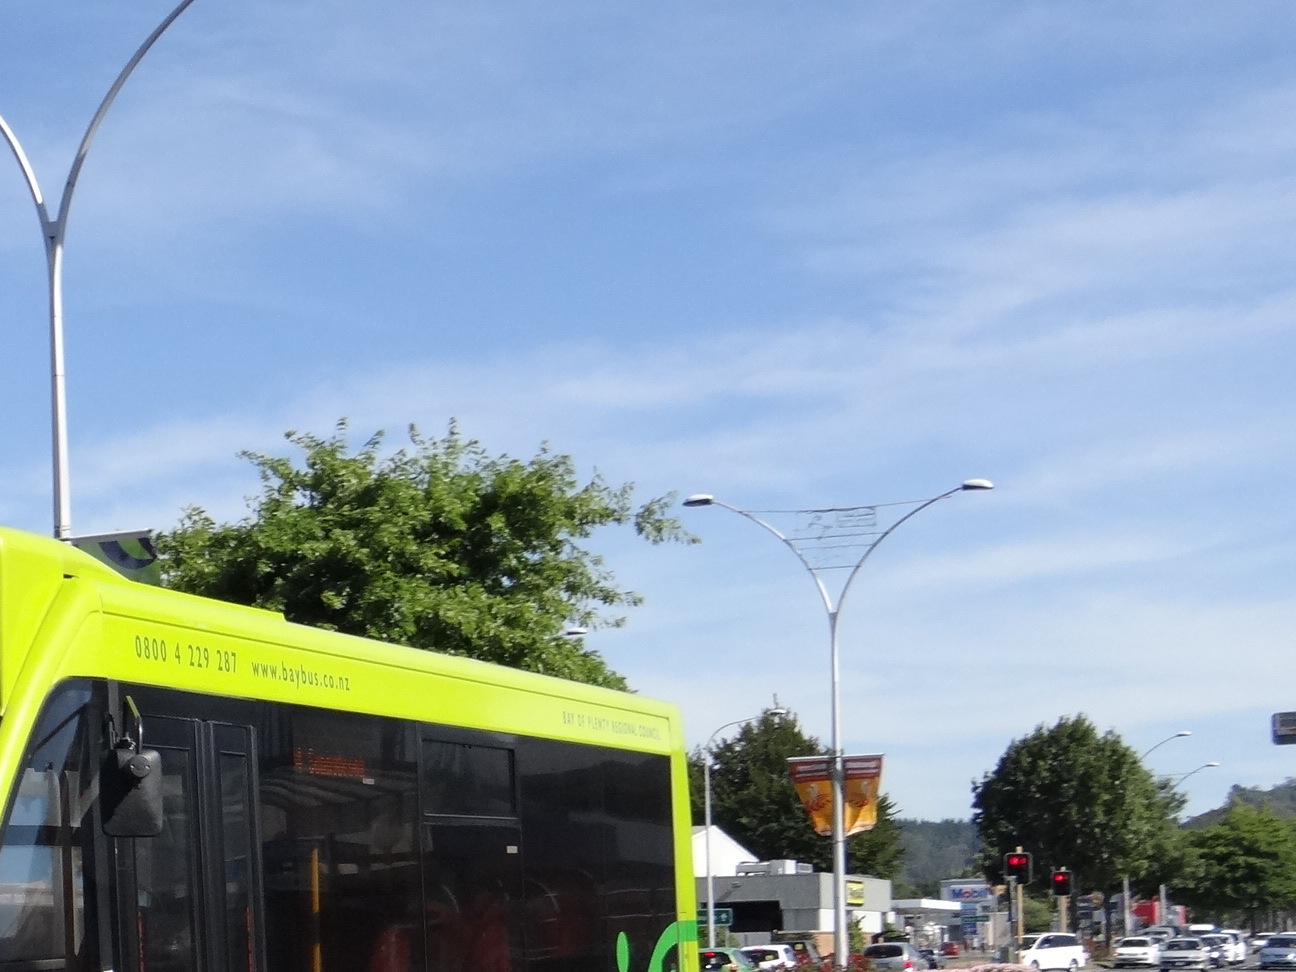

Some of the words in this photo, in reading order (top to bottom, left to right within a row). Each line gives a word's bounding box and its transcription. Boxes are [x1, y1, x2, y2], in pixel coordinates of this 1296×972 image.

[135, 635, 167, 663] 0800
[174, 642, 182, 665] 4
[187, 644, 210, 669] 229
[216, 649, 237, 674] 287
[251, 660, 351, 692] www.baybus.co.nz
